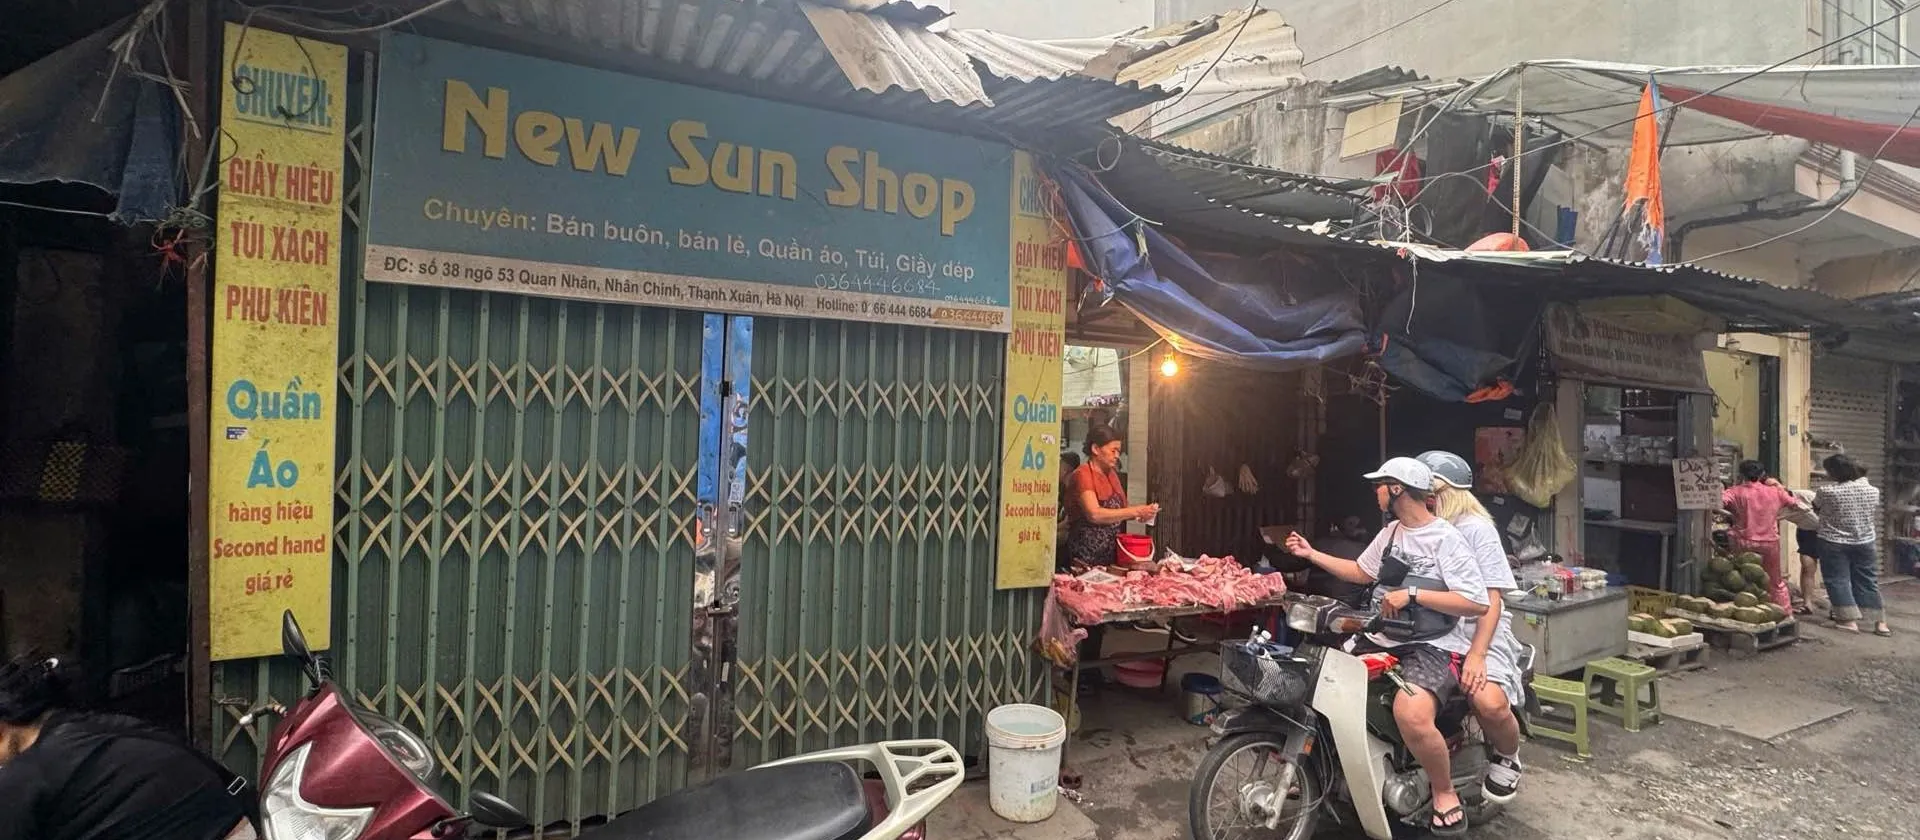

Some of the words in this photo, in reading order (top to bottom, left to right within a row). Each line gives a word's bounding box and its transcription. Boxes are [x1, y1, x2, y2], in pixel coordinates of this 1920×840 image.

[235, 64, 332, 128] CHUYÊN:
[443, 79, 640, 176] New
[669, 120, 797, 200] Sun
[825, 146, 975, 237] Shop
[231, 213, 265, 260] TÚI
[271, 220, 329, 265] XÁCH
[424, 198, 537, 231] Chuyên:
[547, 213, 595, 238] Bán
[604, 219, 670, 249] buôn,
[679, 229, 719, 251] bán
[727, 234, 750, 257] lẻ,
[759, 236, 813, 262] Quần
[820, 250, 848, 268] áo,
[856, 250, 889, 272] Túi,
[896, 252, 936, 280] Giầy
[942, 260, 975, 281] dép
[384, 256, 413, 274] ĐC:
[418, 258, 437, 276] số
[442, 262, 460, 278] 38
[464, 265, 493, 283] ngõ
[499, 267, 515, 283] 53
[519, 269, 557, 288] Quan
[561, 271, 601, 293] Nhân,
[604, 273, 639, 295] Nhân
[729, 288, 762, 306] Xuân,
[785, 294, 804, 310] Nội
[816, 297, 858, 313] Hotline:
[889, 304, 906, 317] 444
[909, 305, 932, 319] 6684
[226, 375, 321, 421] Quần
[1013, 392, 1057, 424] Quần
[247, 438, 299, 488] Áo
[1021, 436, 1045, 470] Áo
[1012, 479, 1032, 495] hàng
[1034, 478, 1051, 494] hiệu
[229, 501, 271, 525] hàng
[276, 501, 314, 523] hiệu
[1005, 502, 1035, 518] Second
[1036, 503, 1056, 517] hand
[213, 535, 278, 559] Second
[282, 534, 325, 555] hand
[1018, 528, 1030, 544] giá
[245, 570, 272, 595] giá
[275, 568, 294, 589] rẻ
